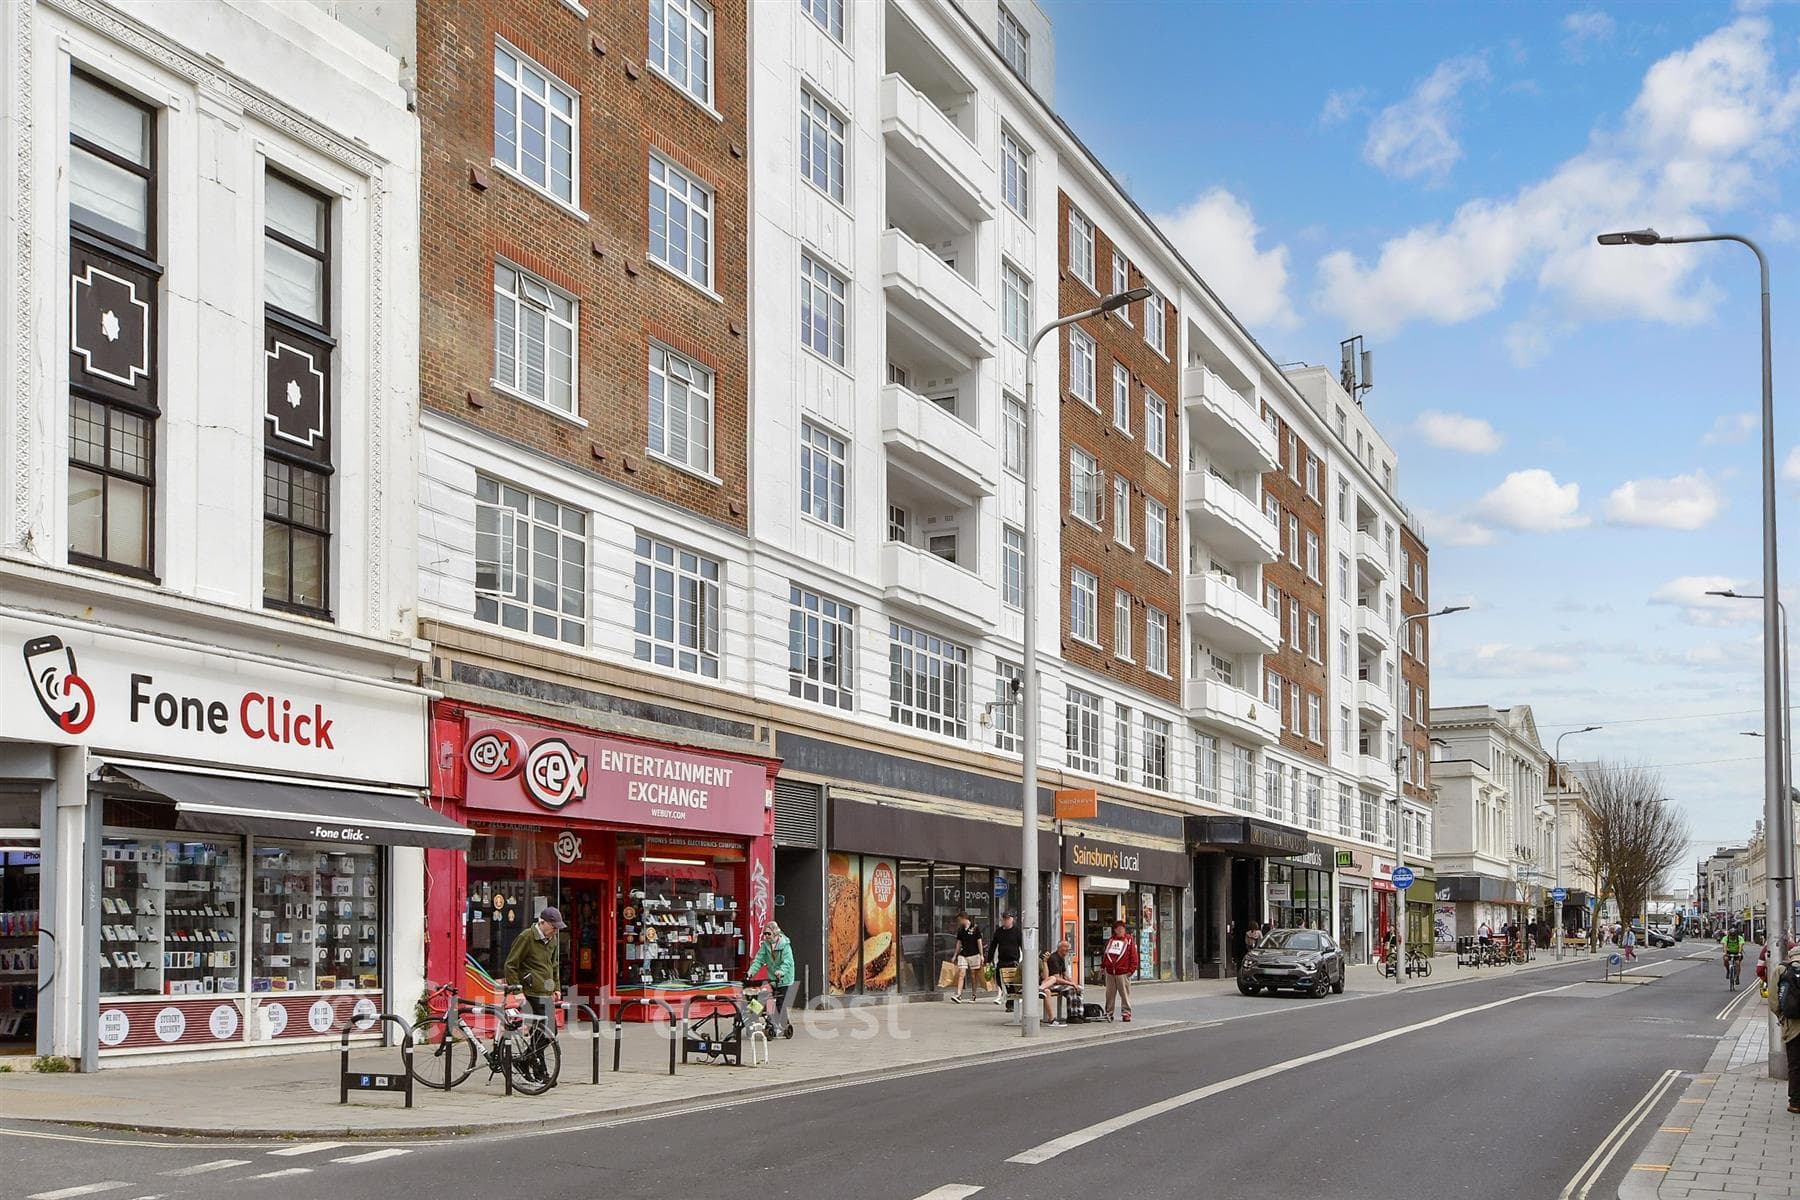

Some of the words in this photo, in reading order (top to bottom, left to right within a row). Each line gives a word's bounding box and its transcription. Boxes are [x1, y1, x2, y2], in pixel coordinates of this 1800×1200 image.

[130, 673, 229, 734] Fone
[240, 692, 335, 750] Click
[601, 749, 733, 788] ENTERTAINMENT
[628, 781, 708, 809] EXCHANGE
[651, 808, 686, 820] WEBUY.COM
[1073, 844, 1119, 873] Sainsbury's
[1120, 852, 1139, 872] Local
[877, 893, 888, 903] DAY
